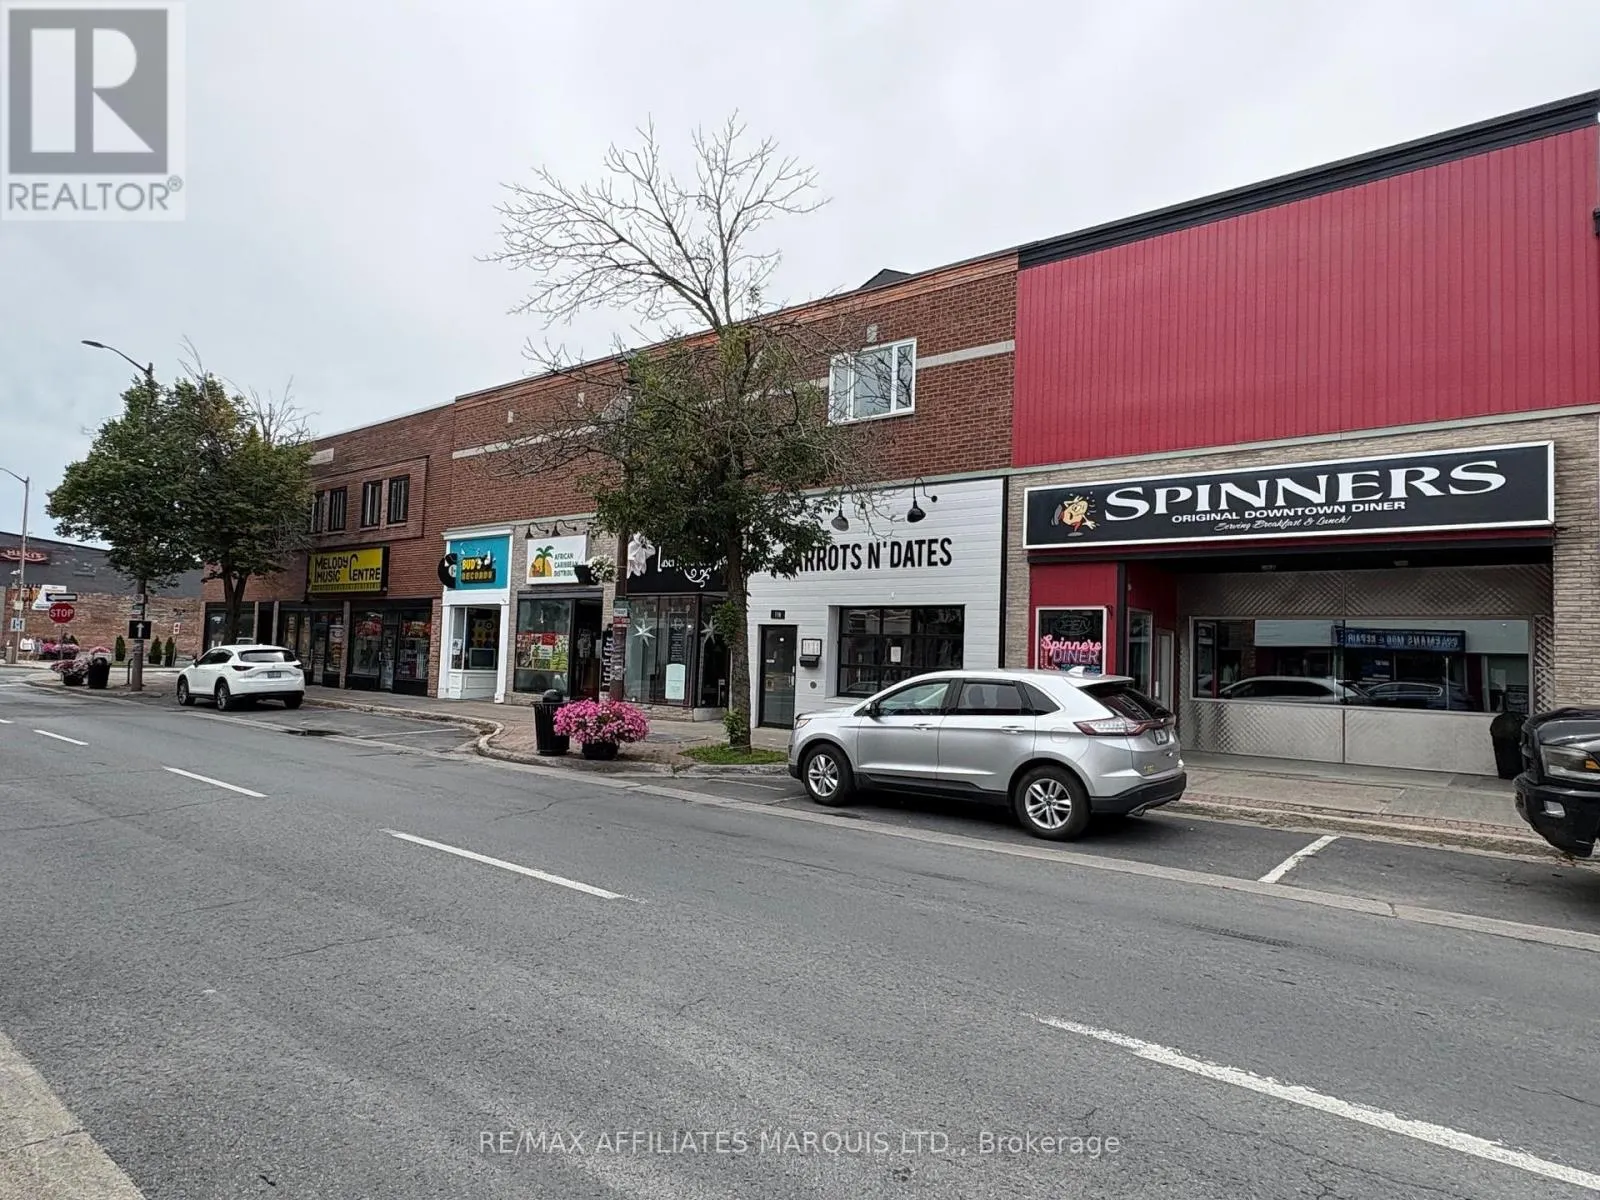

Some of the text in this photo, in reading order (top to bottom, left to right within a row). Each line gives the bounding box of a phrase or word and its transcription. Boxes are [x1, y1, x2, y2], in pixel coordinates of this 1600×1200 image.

[1105, 460, 1506, 521] SPINNERS
[1171, 500, 1406, 524] ORIGINAL DOWNTOWN DINER
[1213, 515, 1352, 531] Serving Breakfast & Lunch!
[315, 555, 349, 570] MELODY
[796, 541, 863, 572] RROTS
[889, 537, 953, 568] DATES
[315, 570, 341, 582] MUSIC
[350, 553, 381, 581] CENTRE
[50, 609, 74, 618] STOP
[1041, 634, 1102, 656] Spinners
[1053, 649, 1099, 663] DINER
